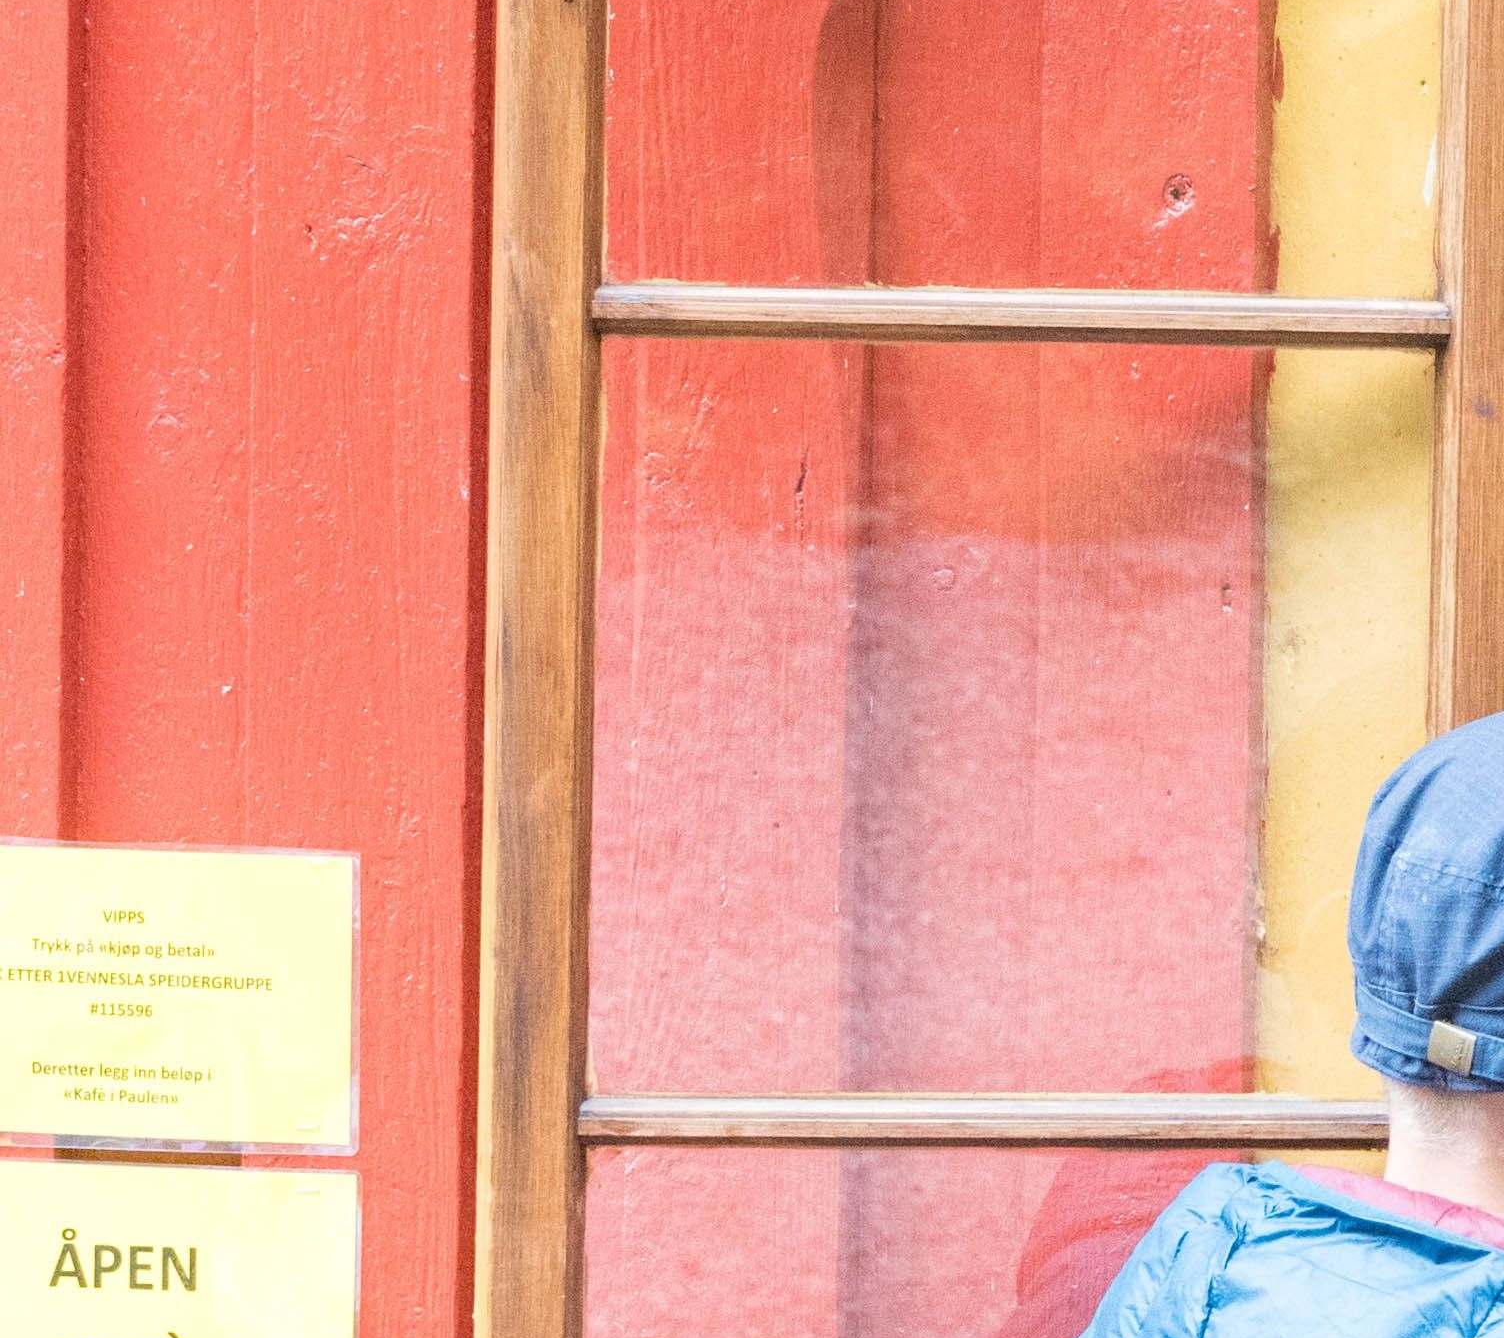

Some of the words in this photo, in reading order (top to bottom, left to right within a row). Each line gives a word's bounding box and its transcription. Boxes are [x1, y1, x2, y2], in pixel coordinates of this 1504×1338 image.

[102, 910, 145, 925] VIPPS
[31, 937, 72, 955] Trykk
[75, 939, 94, 957] på
[144, 944, 164, 960] og
[7, 967, 53, 983] ETTER
[57, 969, 145, 987] 1VENNESLA
[148, 973, 273, 992] SPEIDERGRUPPE
[89, 1002, 153, 1018] #115596
[31, 1060, 96, 1078] Deretter
[98, 1063, 130, 1082] legg
[133, 1065, 157, 1080] inn
[160, 1065, 204, 1084] beløp
[48, 1227, 198, 1293] ÅPEN
